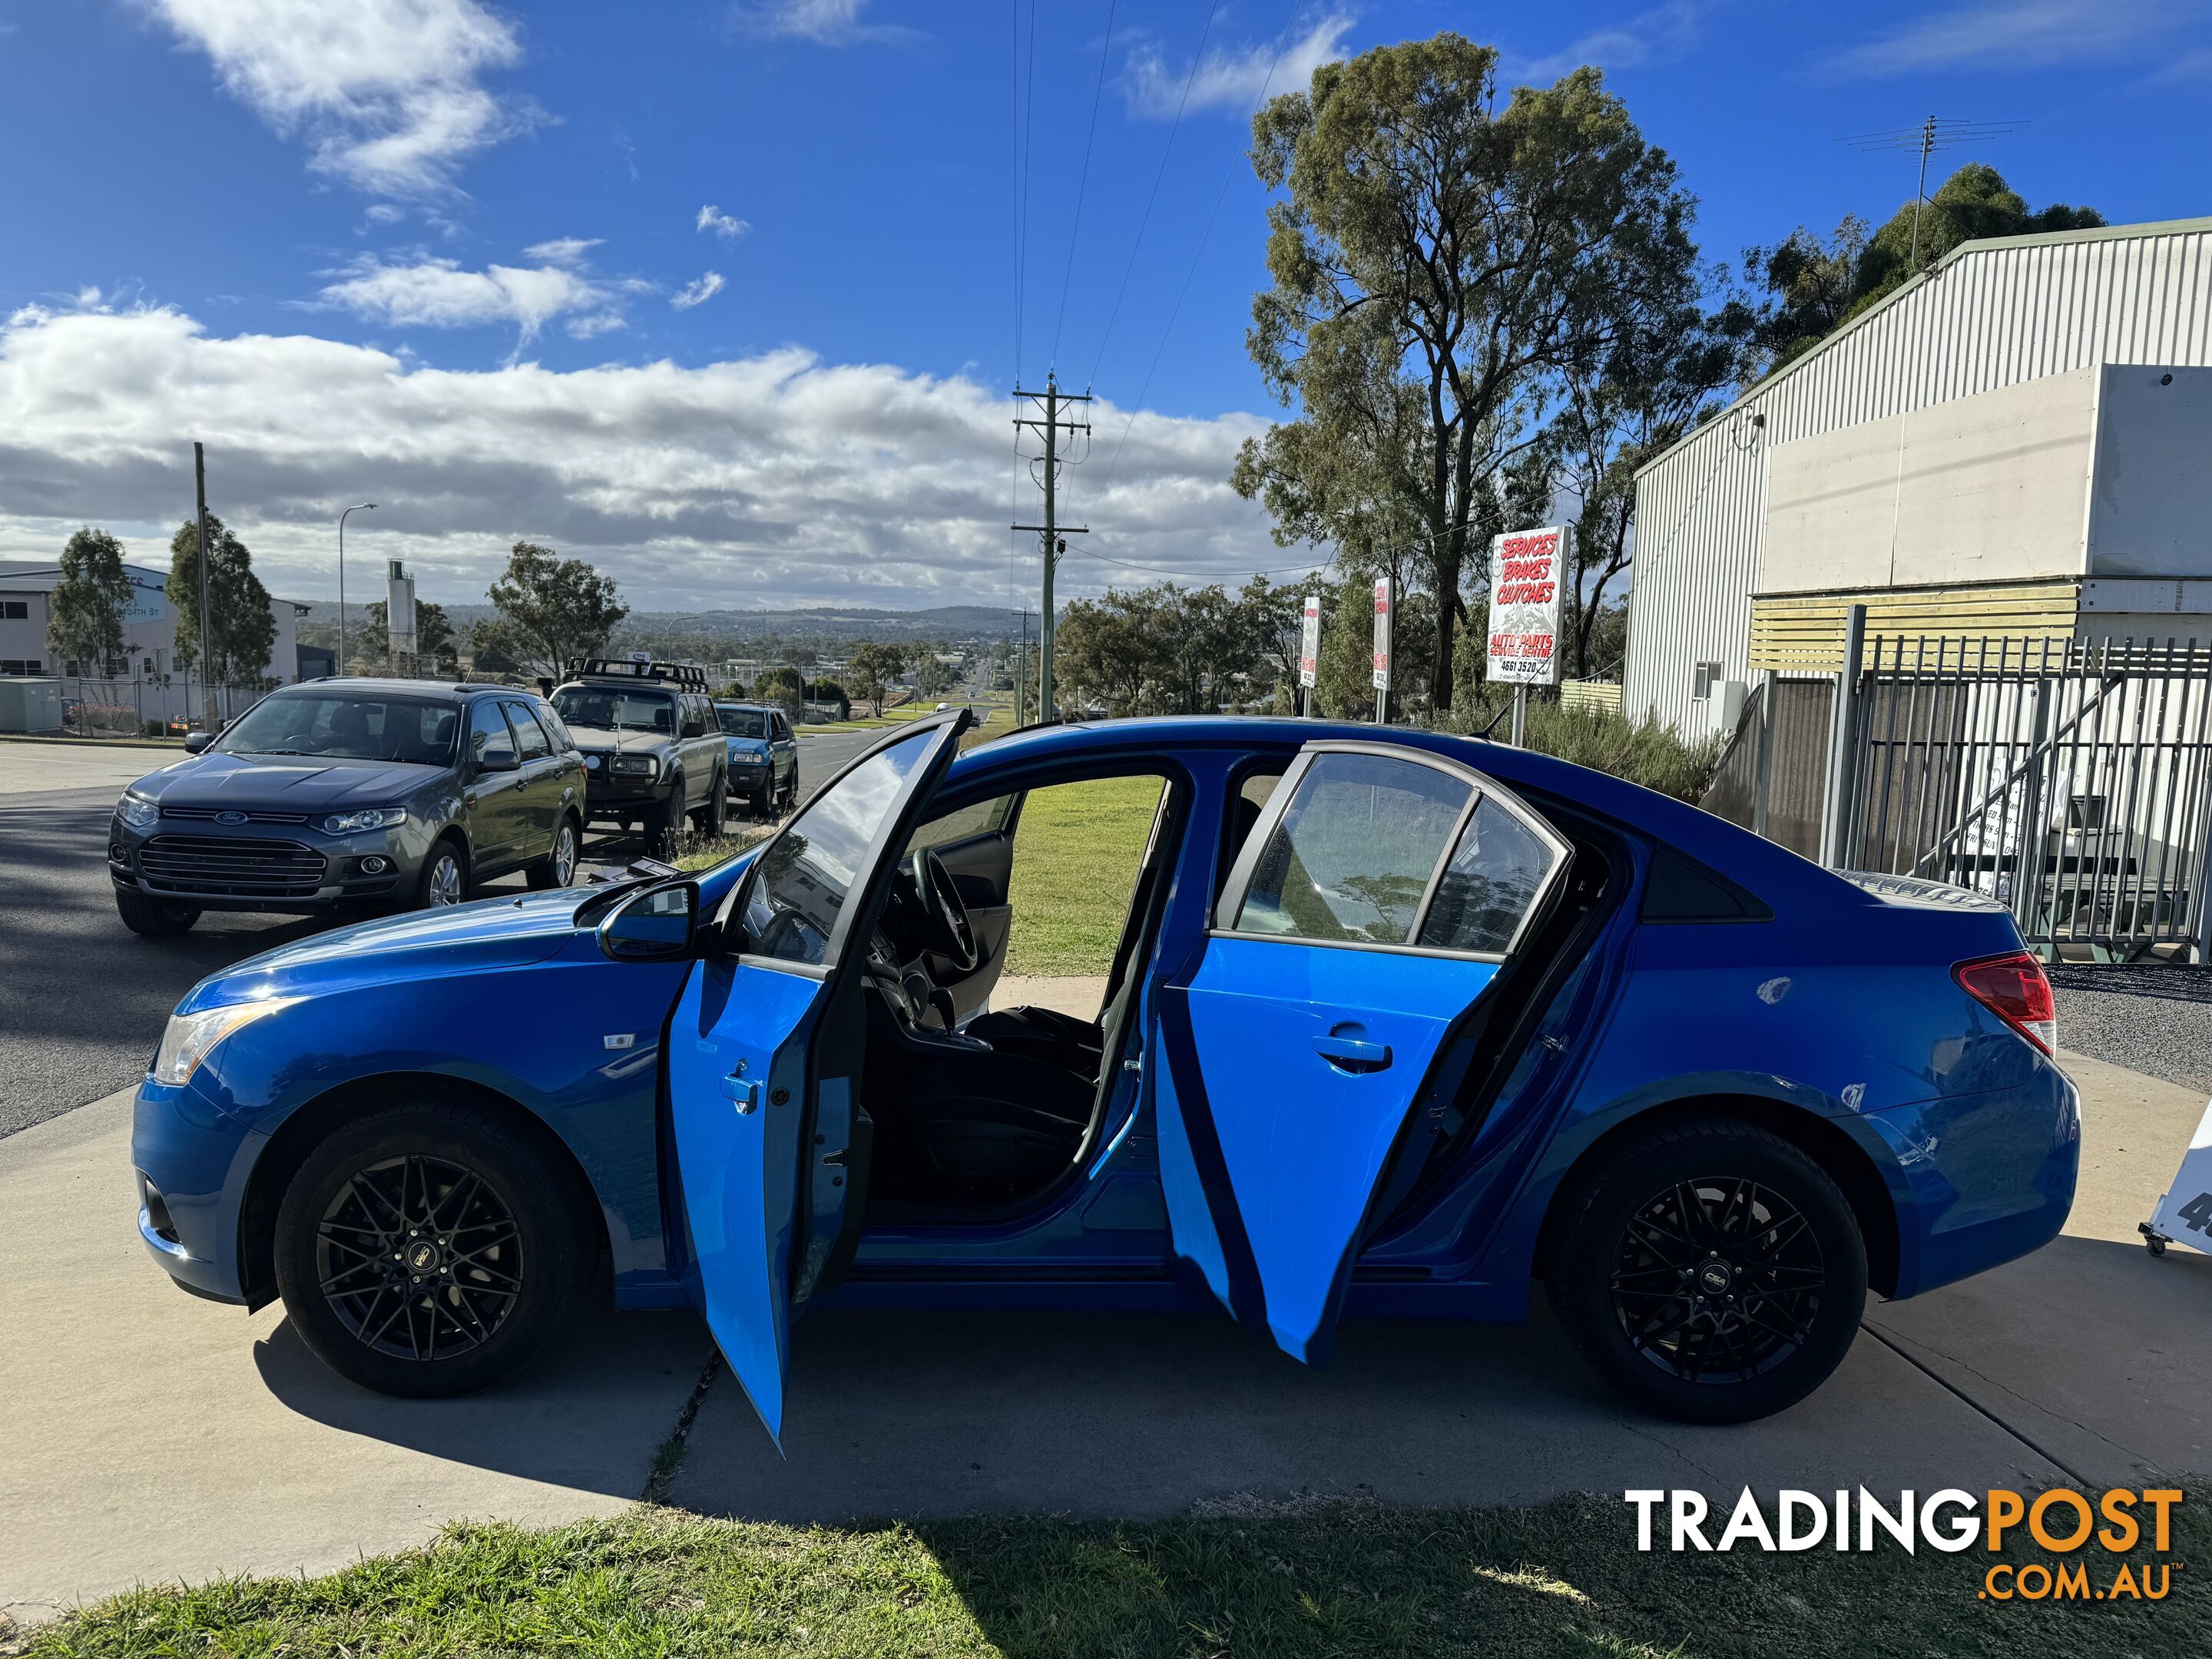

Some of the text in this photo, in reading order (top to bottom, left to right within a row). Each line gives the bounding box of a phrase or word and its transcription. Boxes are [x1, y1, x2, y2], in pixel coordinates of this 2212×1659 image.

[1501, 534, 1558, 560] SERVICES
[1503, 558, 1551, 582] BRAKES
[1497, 581, 1555, 605] CLUTCHES
[1490, 634, 1553, 648] AUTO PARTS
[1490, 647, 1552, 658] SERVICE CENTRE
[1502, 661, 1536, 672] 4661 3520
